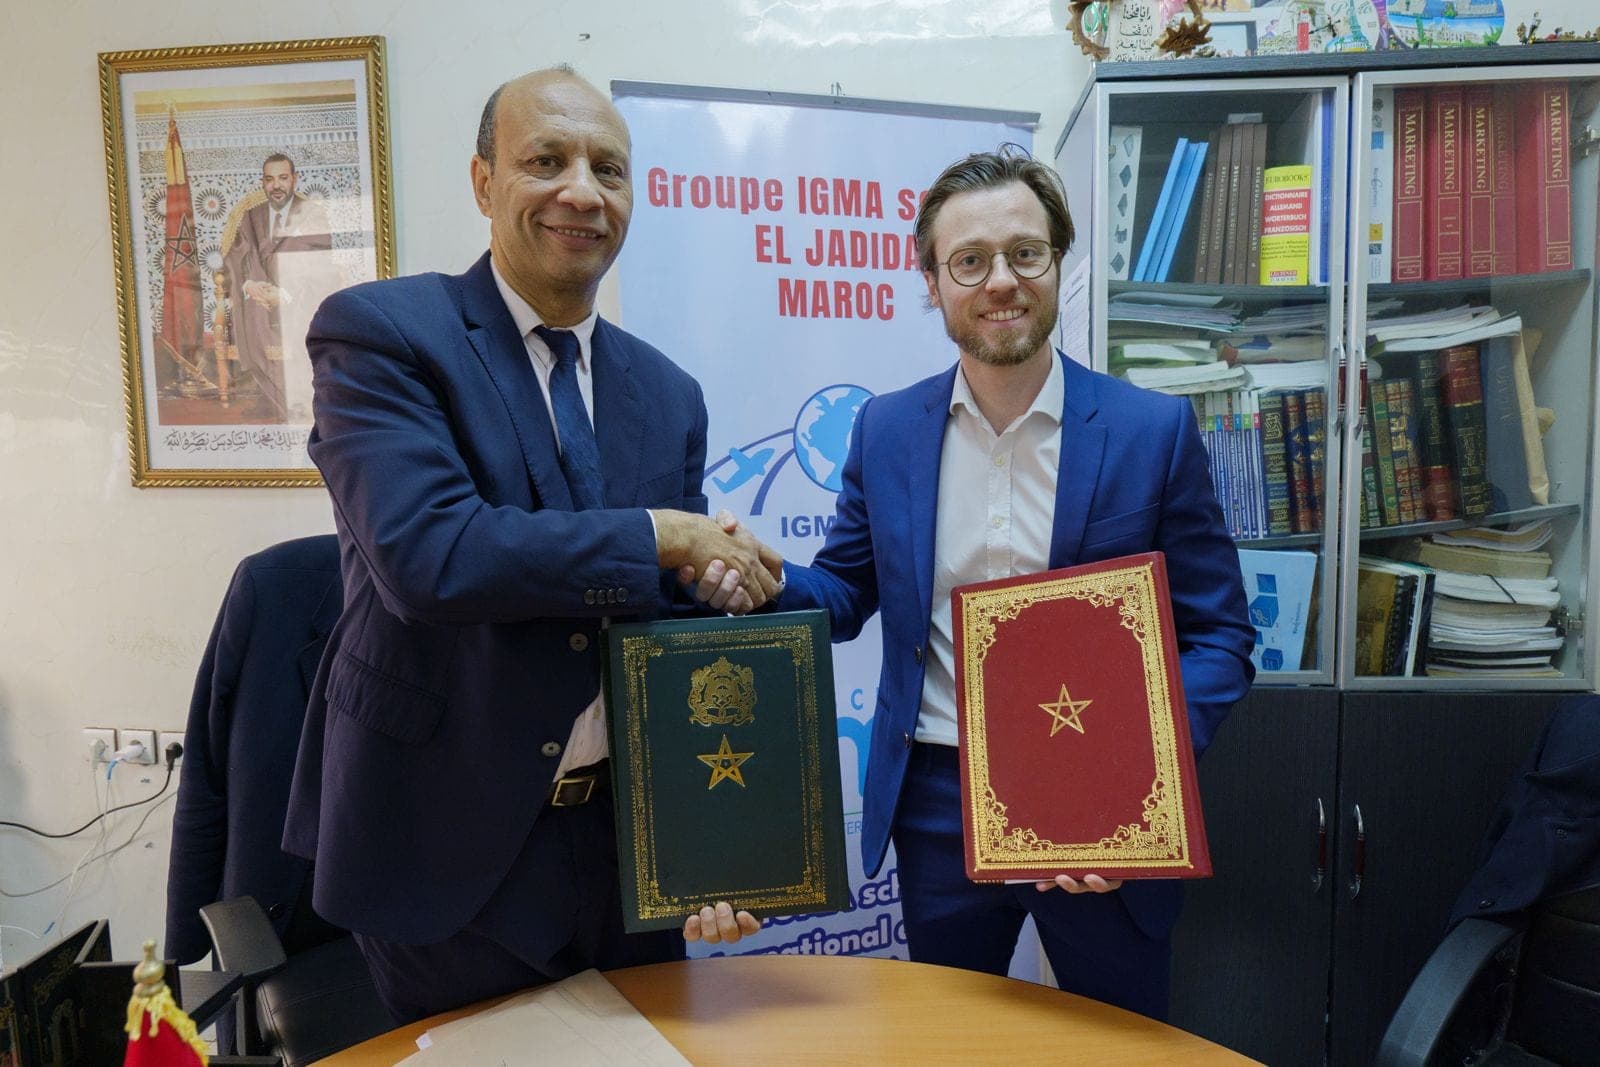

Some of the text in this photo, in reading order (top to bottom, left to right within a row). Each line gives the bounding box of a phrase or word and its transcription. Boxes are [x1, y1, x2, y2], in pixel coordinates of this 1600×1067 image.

[1404, 113, 1417, 196] MARKETING
[1444, 108, 1455, 190] MARKETING
[1475, 108, 1486, 190] MARKETING
[1550, 95, 1563, 179] MARKETING
[647, 167, 783, 215] Groupe
[798, 176, 884, 219] IGMA
[1265, 191, 1308, 201] DICTIONNAIRE
[1269, 203, 1303, 212] ALLEMAND
[754, 224, 920, 271] EL JADIDA
[778, 277, 894, 321] MAROC
